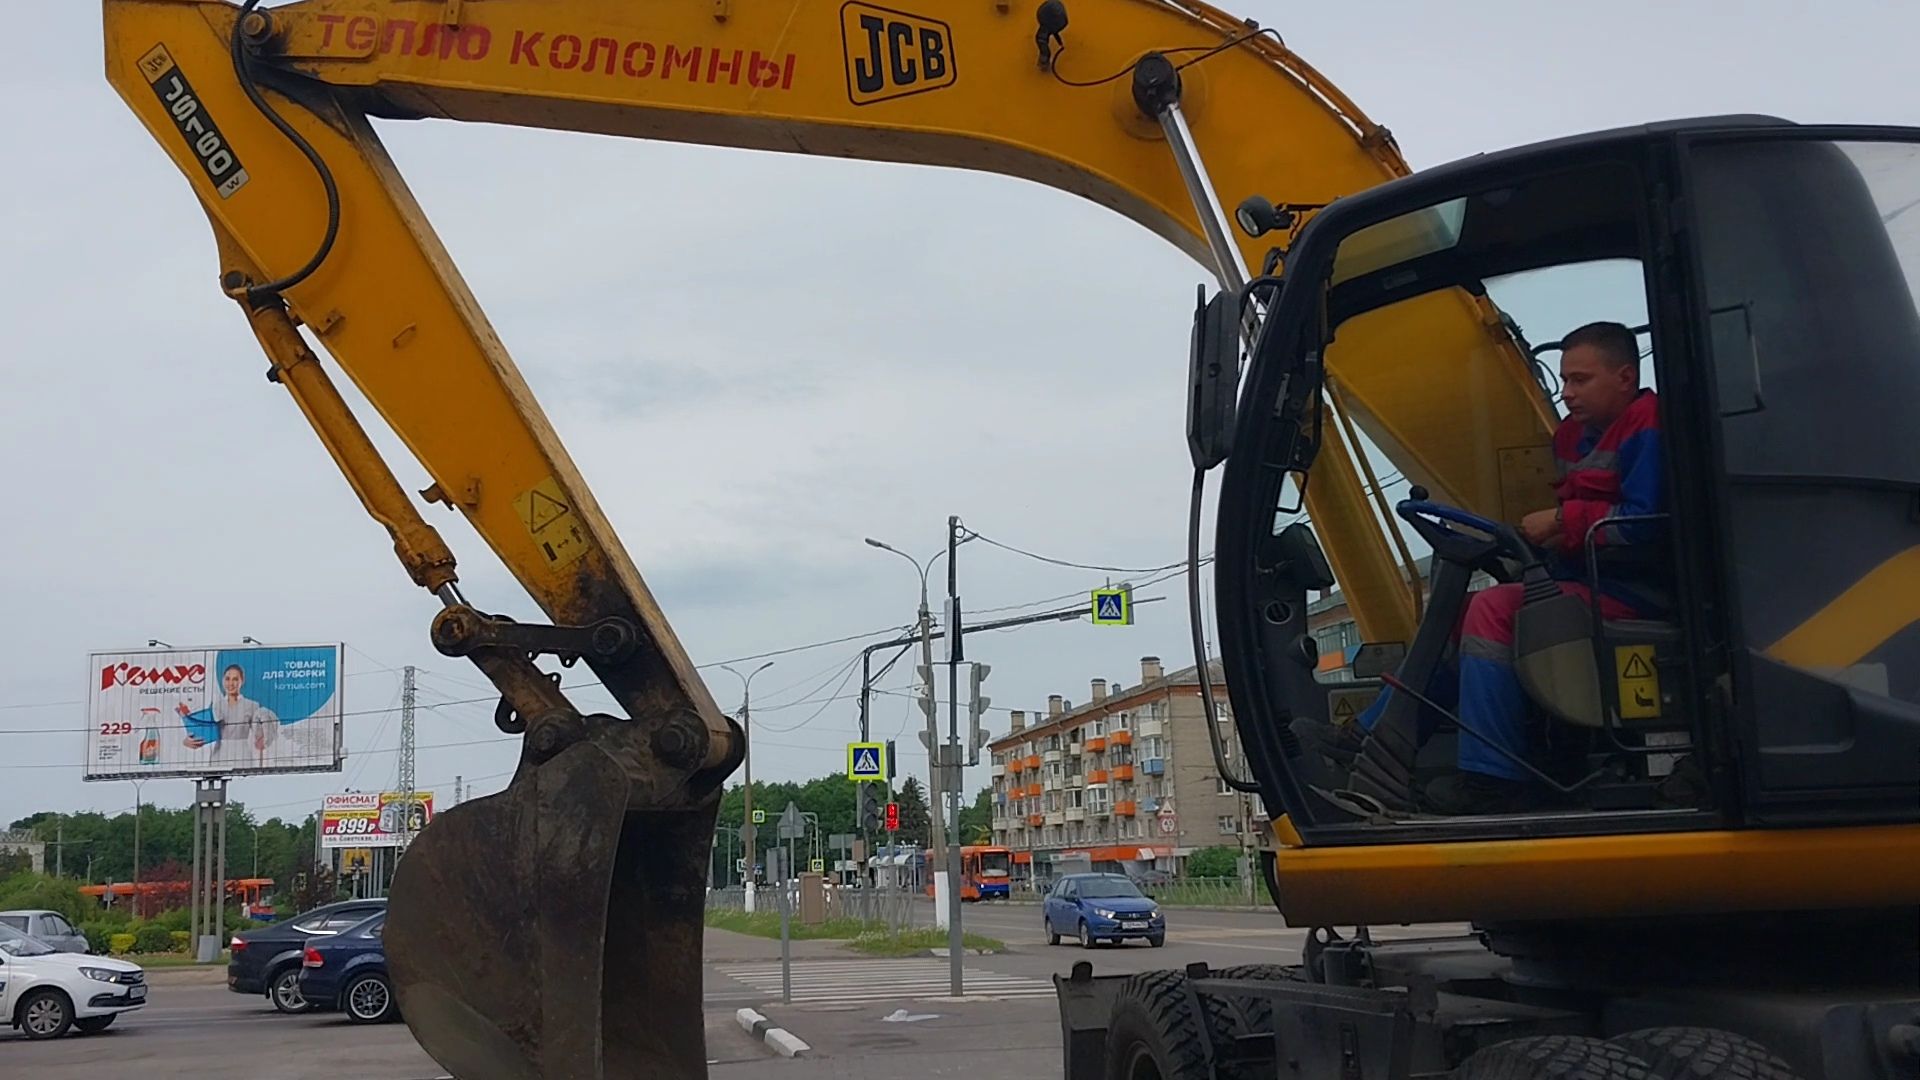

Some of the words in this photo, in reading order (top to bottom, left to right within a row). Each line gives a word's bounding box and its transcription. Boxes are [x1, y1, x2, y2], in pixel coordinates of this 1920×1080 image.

[509, 29, 796, 90] КОЛОМНЫ
[854, 14, 946, 94] JCB
[165, 76, 233, 175] JS160
[284, 660, 326, 669] ТОВАРЫ
[262, 671, 284, 680] ДЛЯ
[286, 669, 326, 679] УБОРКИ
[100, 722, 132, 736] 229
[326, 796, 377, 805] ОФИСМАГ
[336, 818, 368, 834] 899
